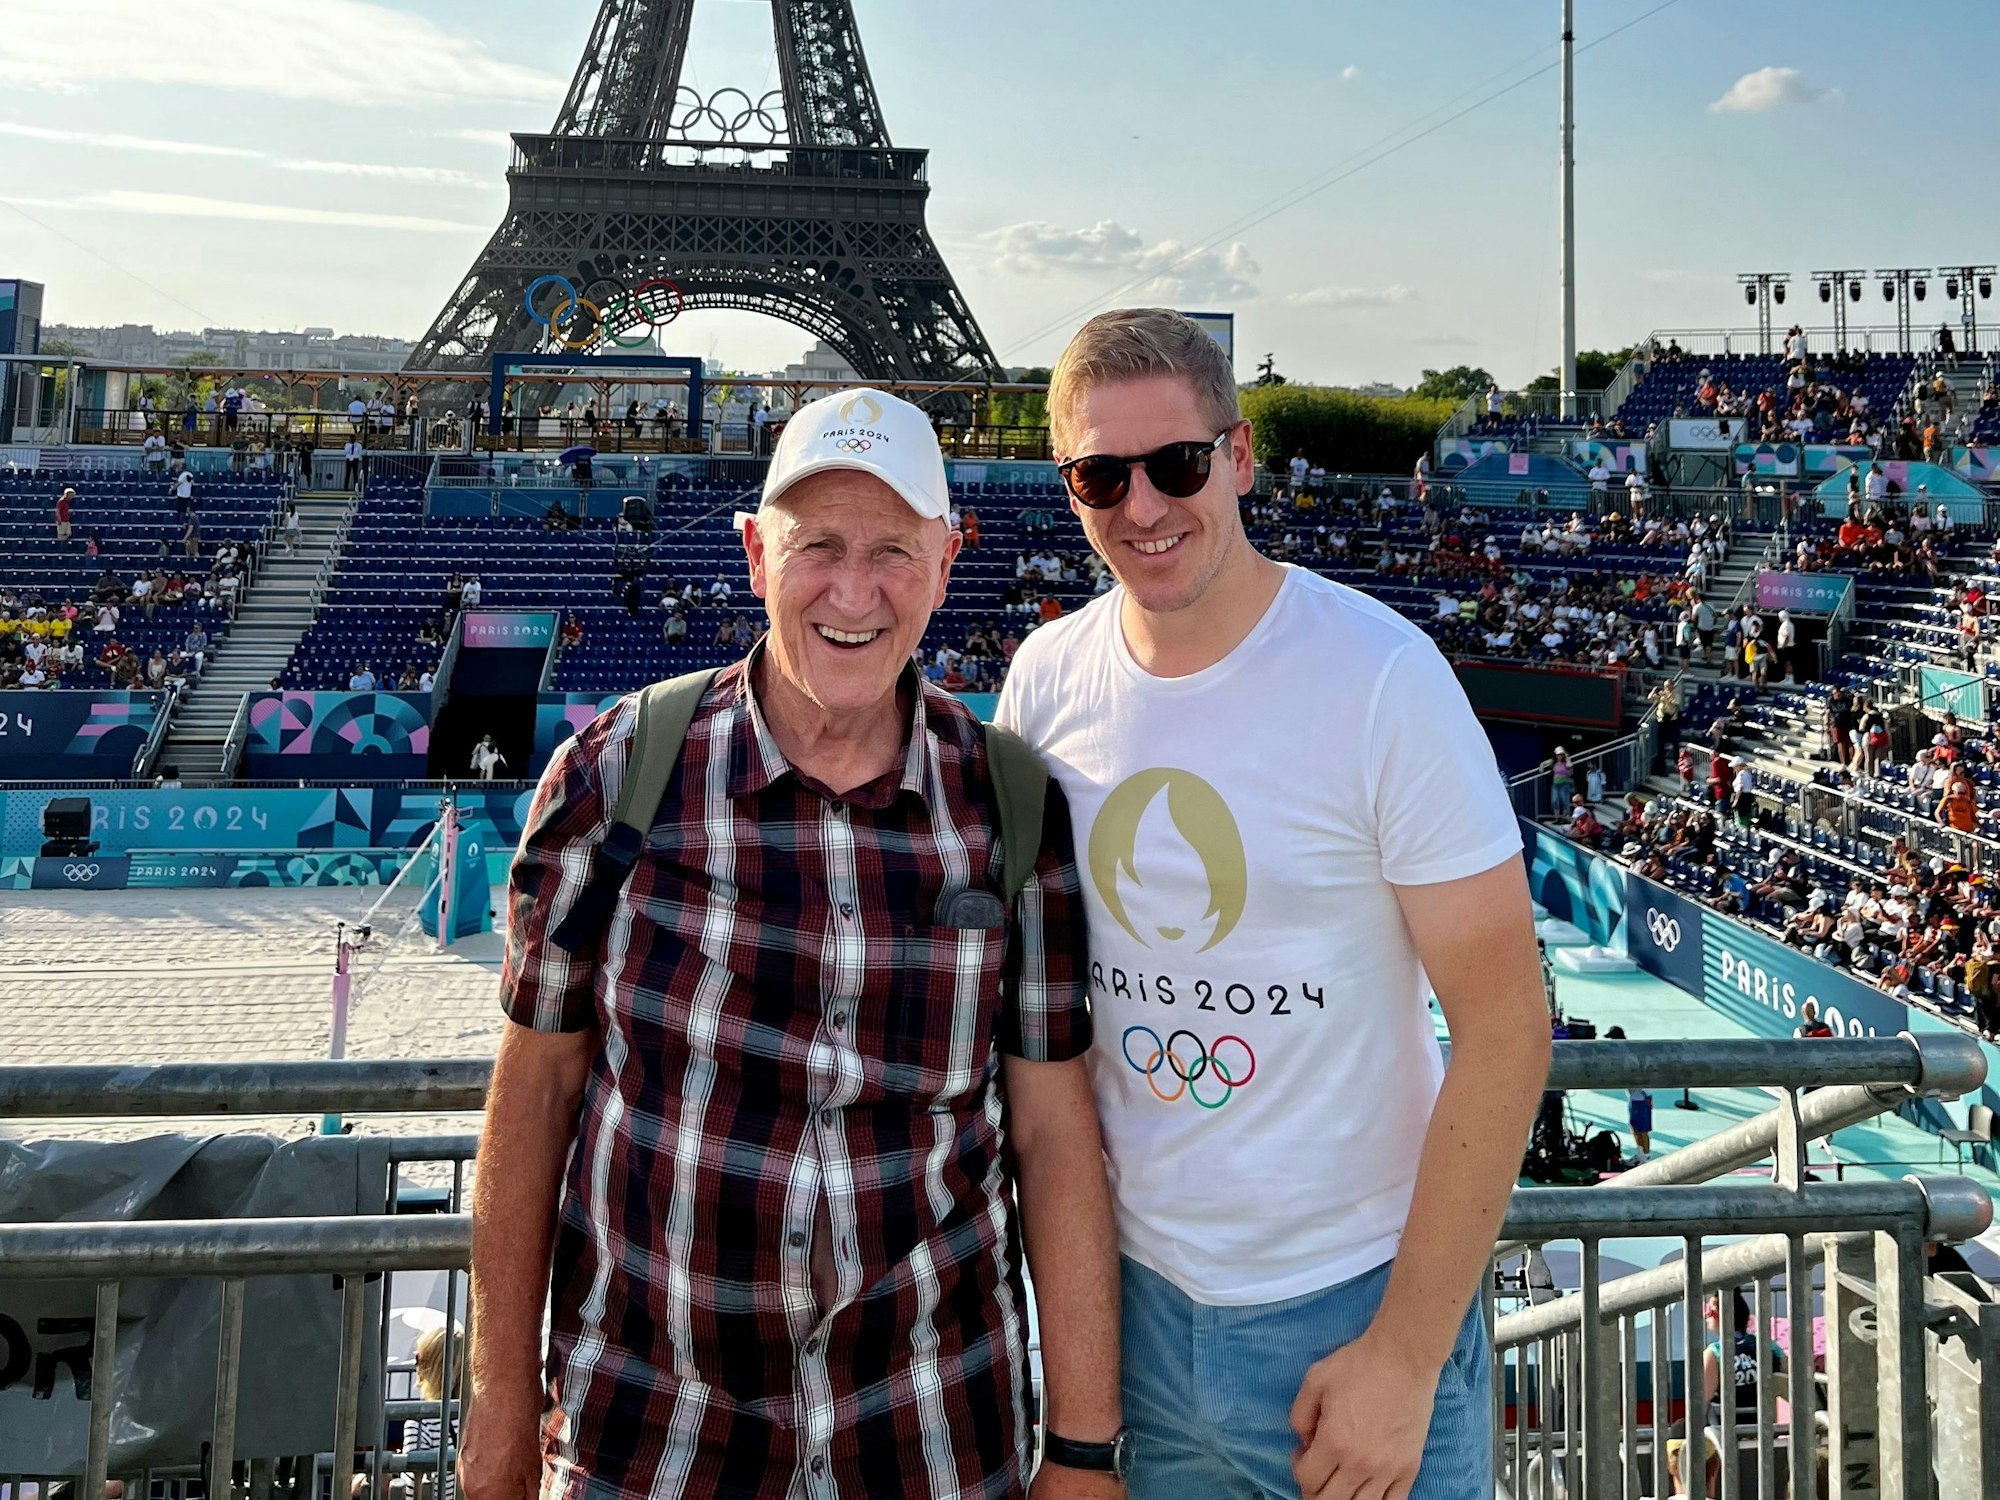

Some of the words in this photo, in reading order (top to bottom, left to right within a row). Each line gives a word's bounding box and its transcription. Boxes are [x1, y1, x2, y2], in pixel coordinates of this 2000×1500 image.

[859, 429, 890, 442] 2024
[513, 625, 548, 635] 2024
[168, 806, 267, 830] 2024
[180, 866, 217, 877] 2024
[1194, 980, 1325, 1016] 2024
